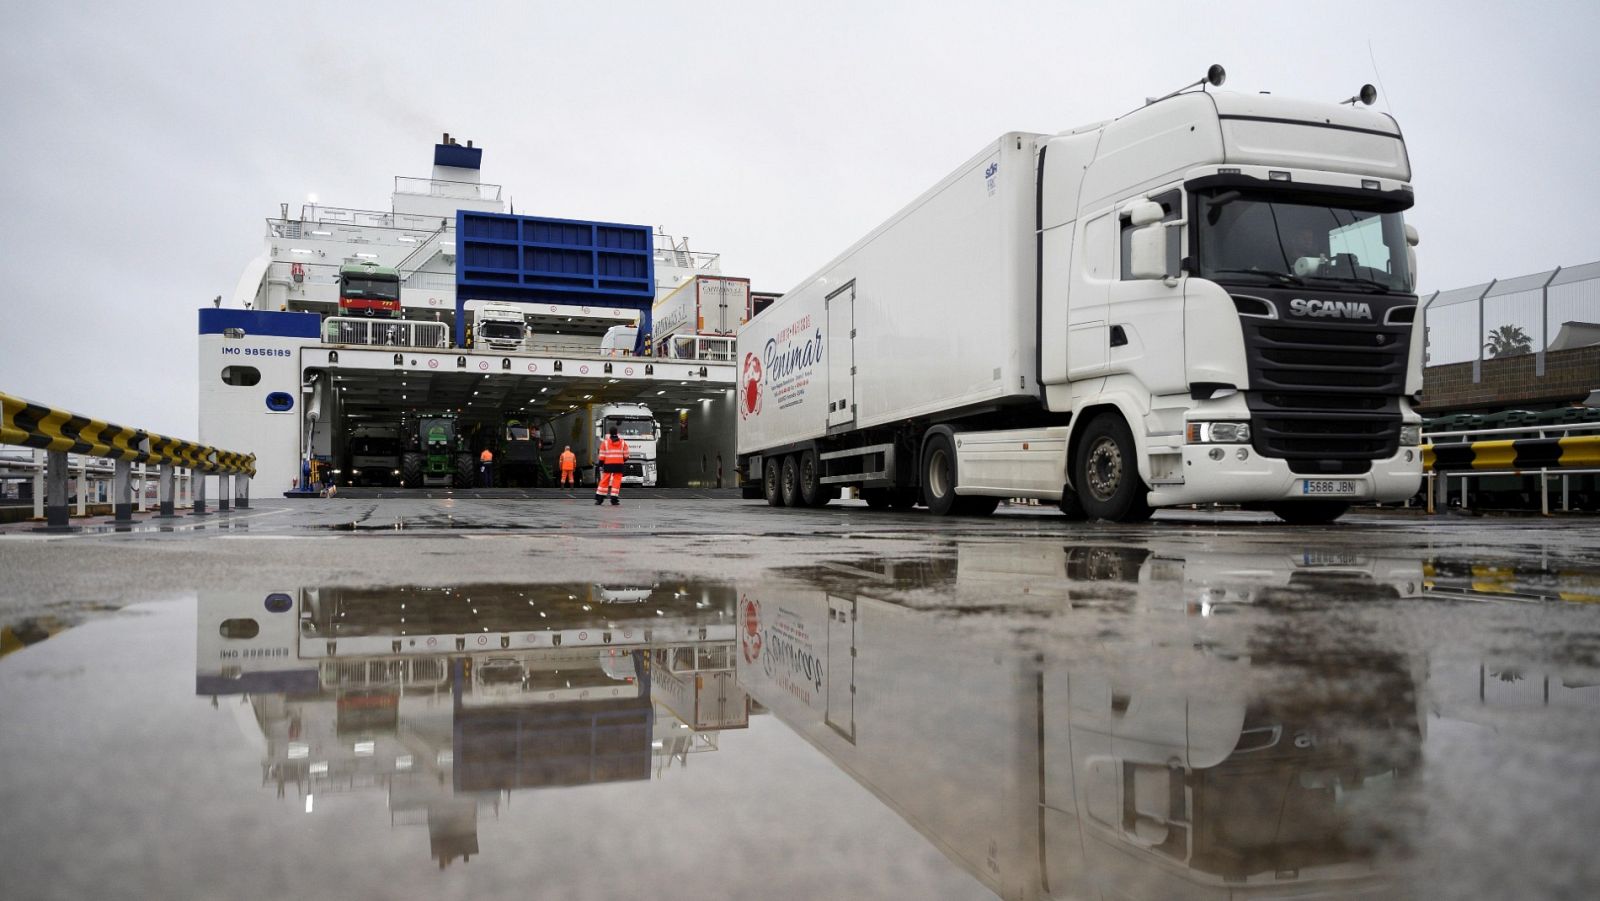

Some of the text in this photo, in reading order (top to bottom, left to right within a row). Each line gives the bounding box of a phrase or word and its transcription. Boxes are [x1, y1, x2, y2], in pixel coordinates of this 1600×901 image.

[1289, 298, 1373, 320] SCANIA
[222, 347, 291, 357] IMO 9856189
[764, 328, 823, 385] Penimar
[1310, 481, 1354, 492] 5686 JBN
